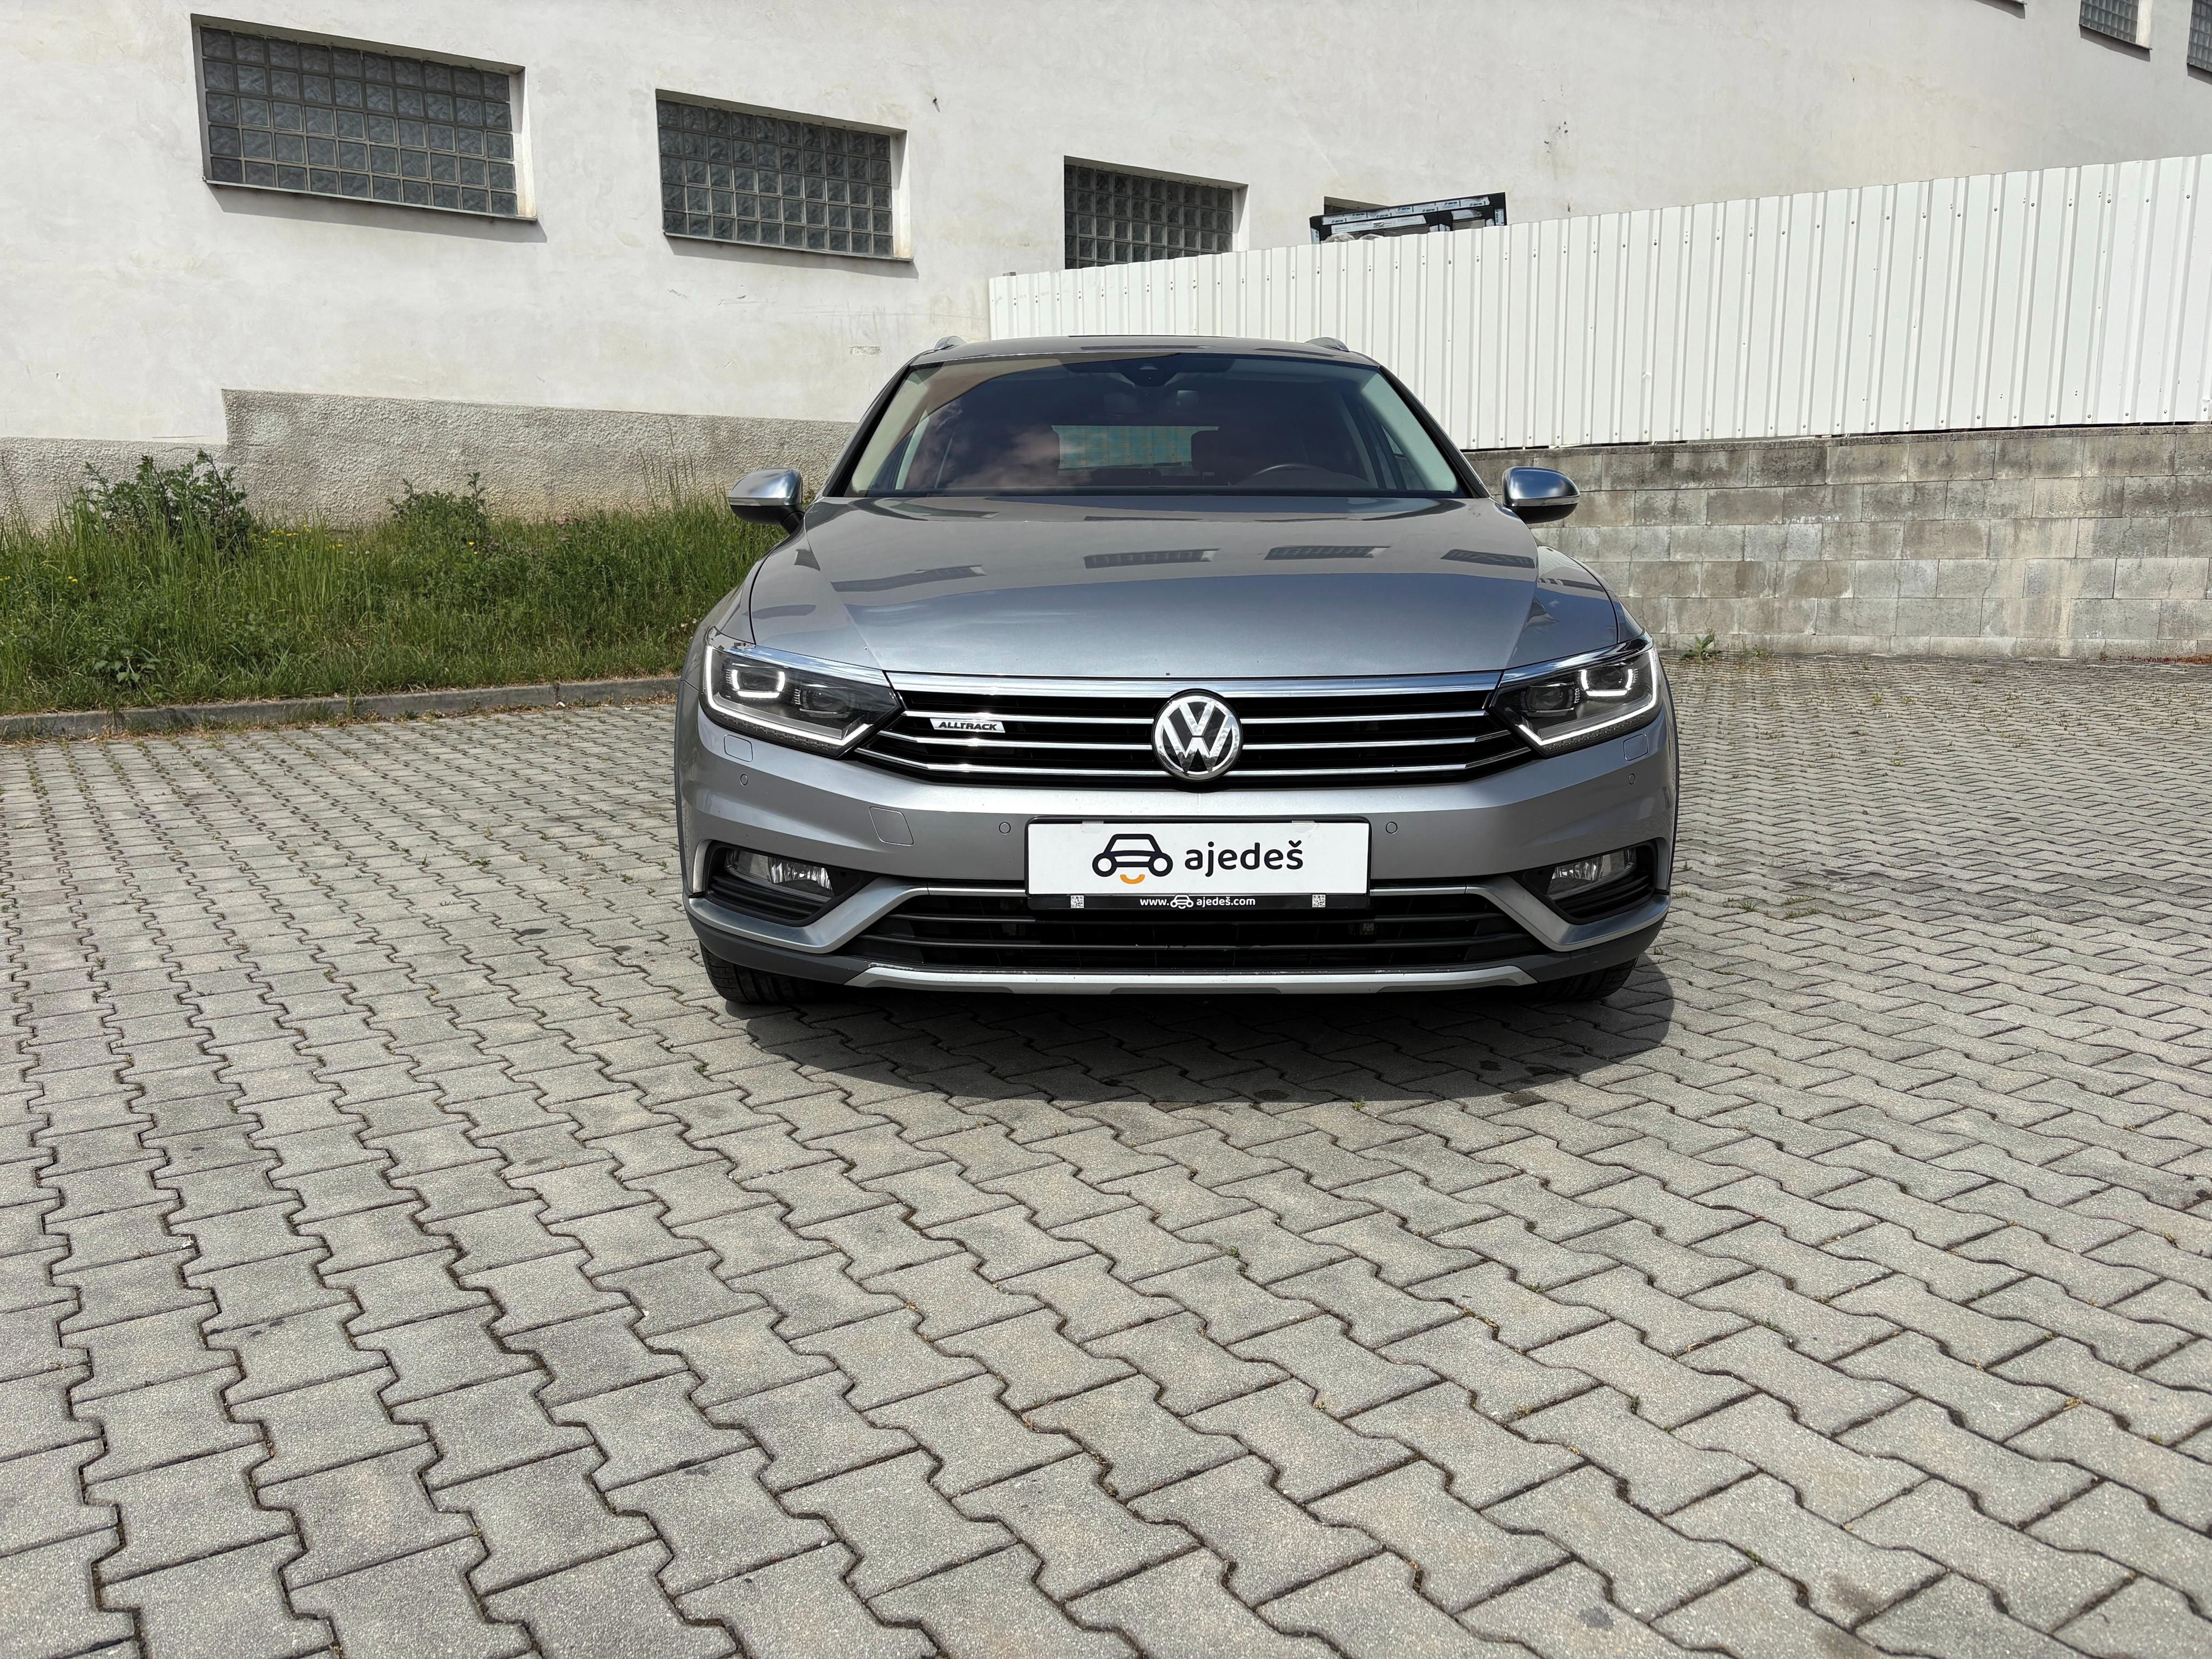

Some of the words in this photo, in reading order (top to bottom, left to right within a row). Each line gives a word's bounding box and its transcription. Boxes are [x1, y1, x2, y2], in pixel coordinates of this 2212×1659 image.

[939, 721, 997, 731] ALLTRACK
[1184, 840, 1303, 878] ajedeš
[1196, 896, 1256, 907] ajedeš.com
